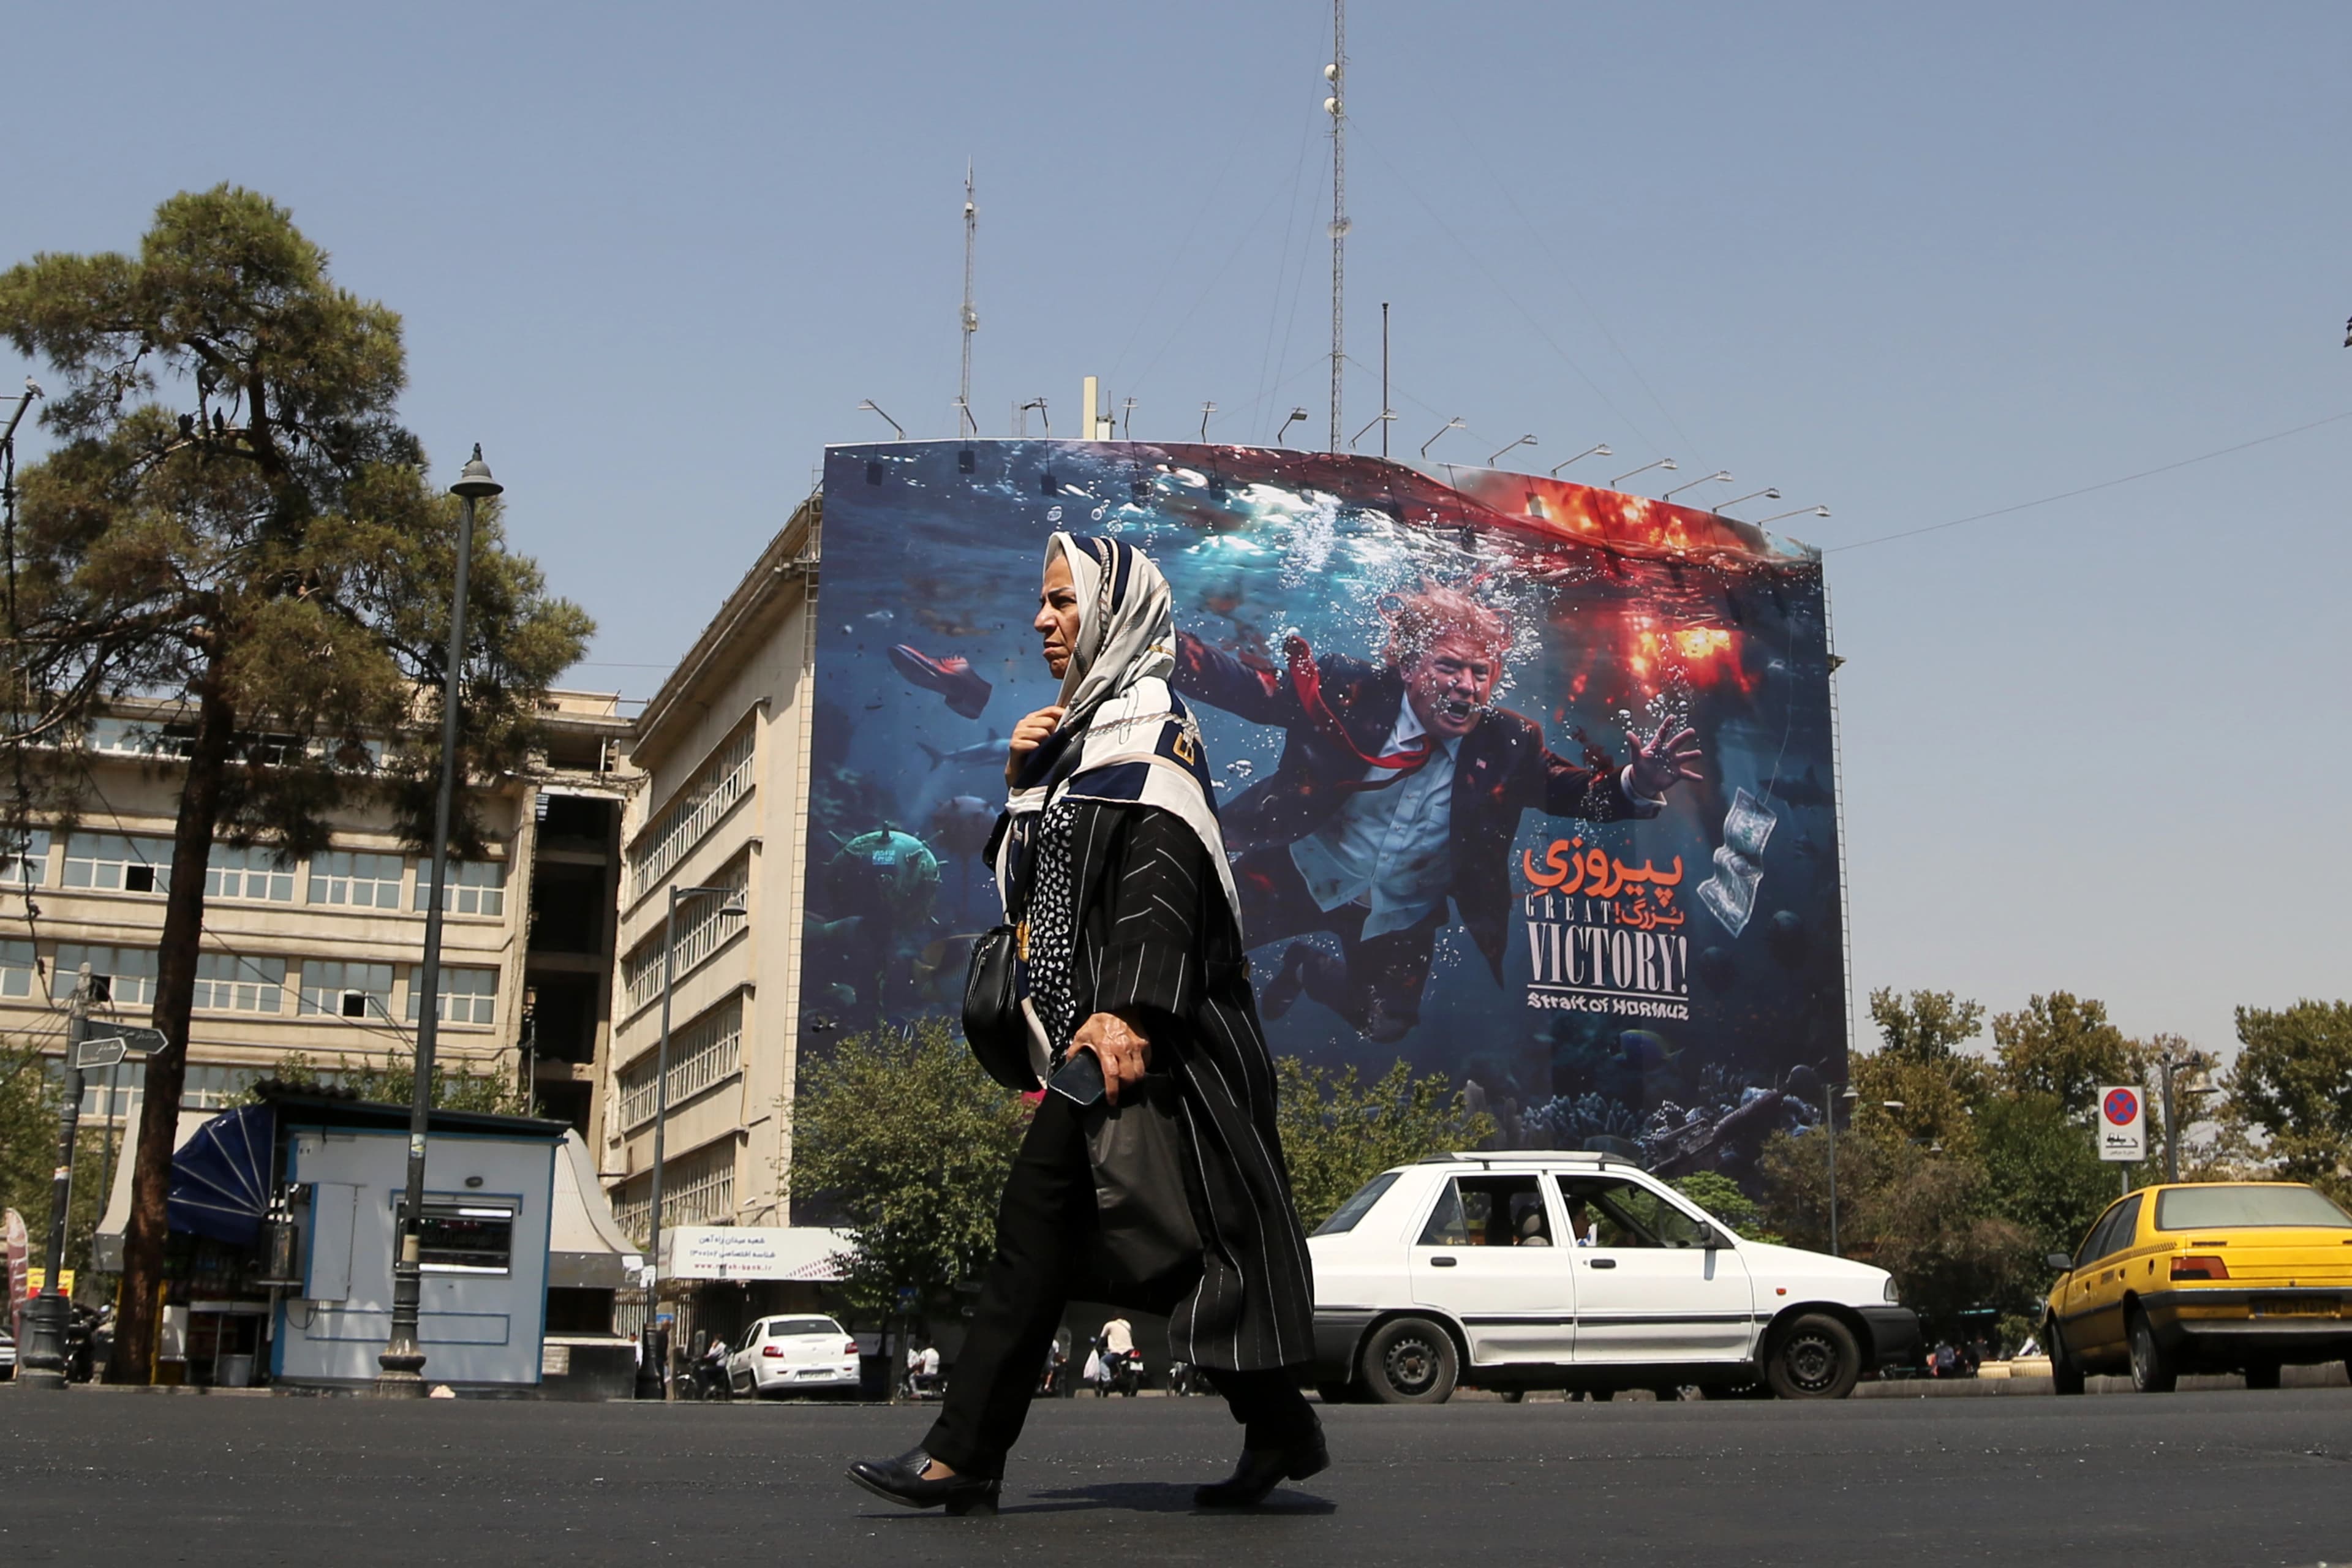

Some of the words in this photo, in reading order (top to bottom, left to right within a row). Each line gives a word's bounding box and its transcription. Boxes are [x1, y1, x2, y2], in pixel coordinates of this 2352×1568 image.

[1525, 894, 1611, 924] GREAT
[1526, 922, 1688, 994] VICTORY!
[1527, 992, 1588, 1012] Strait
[699, 1234, 714, 1244] آهن
[715, 1235, 724, 1245] راه
[725, 1235, 745, 1245] میدان
